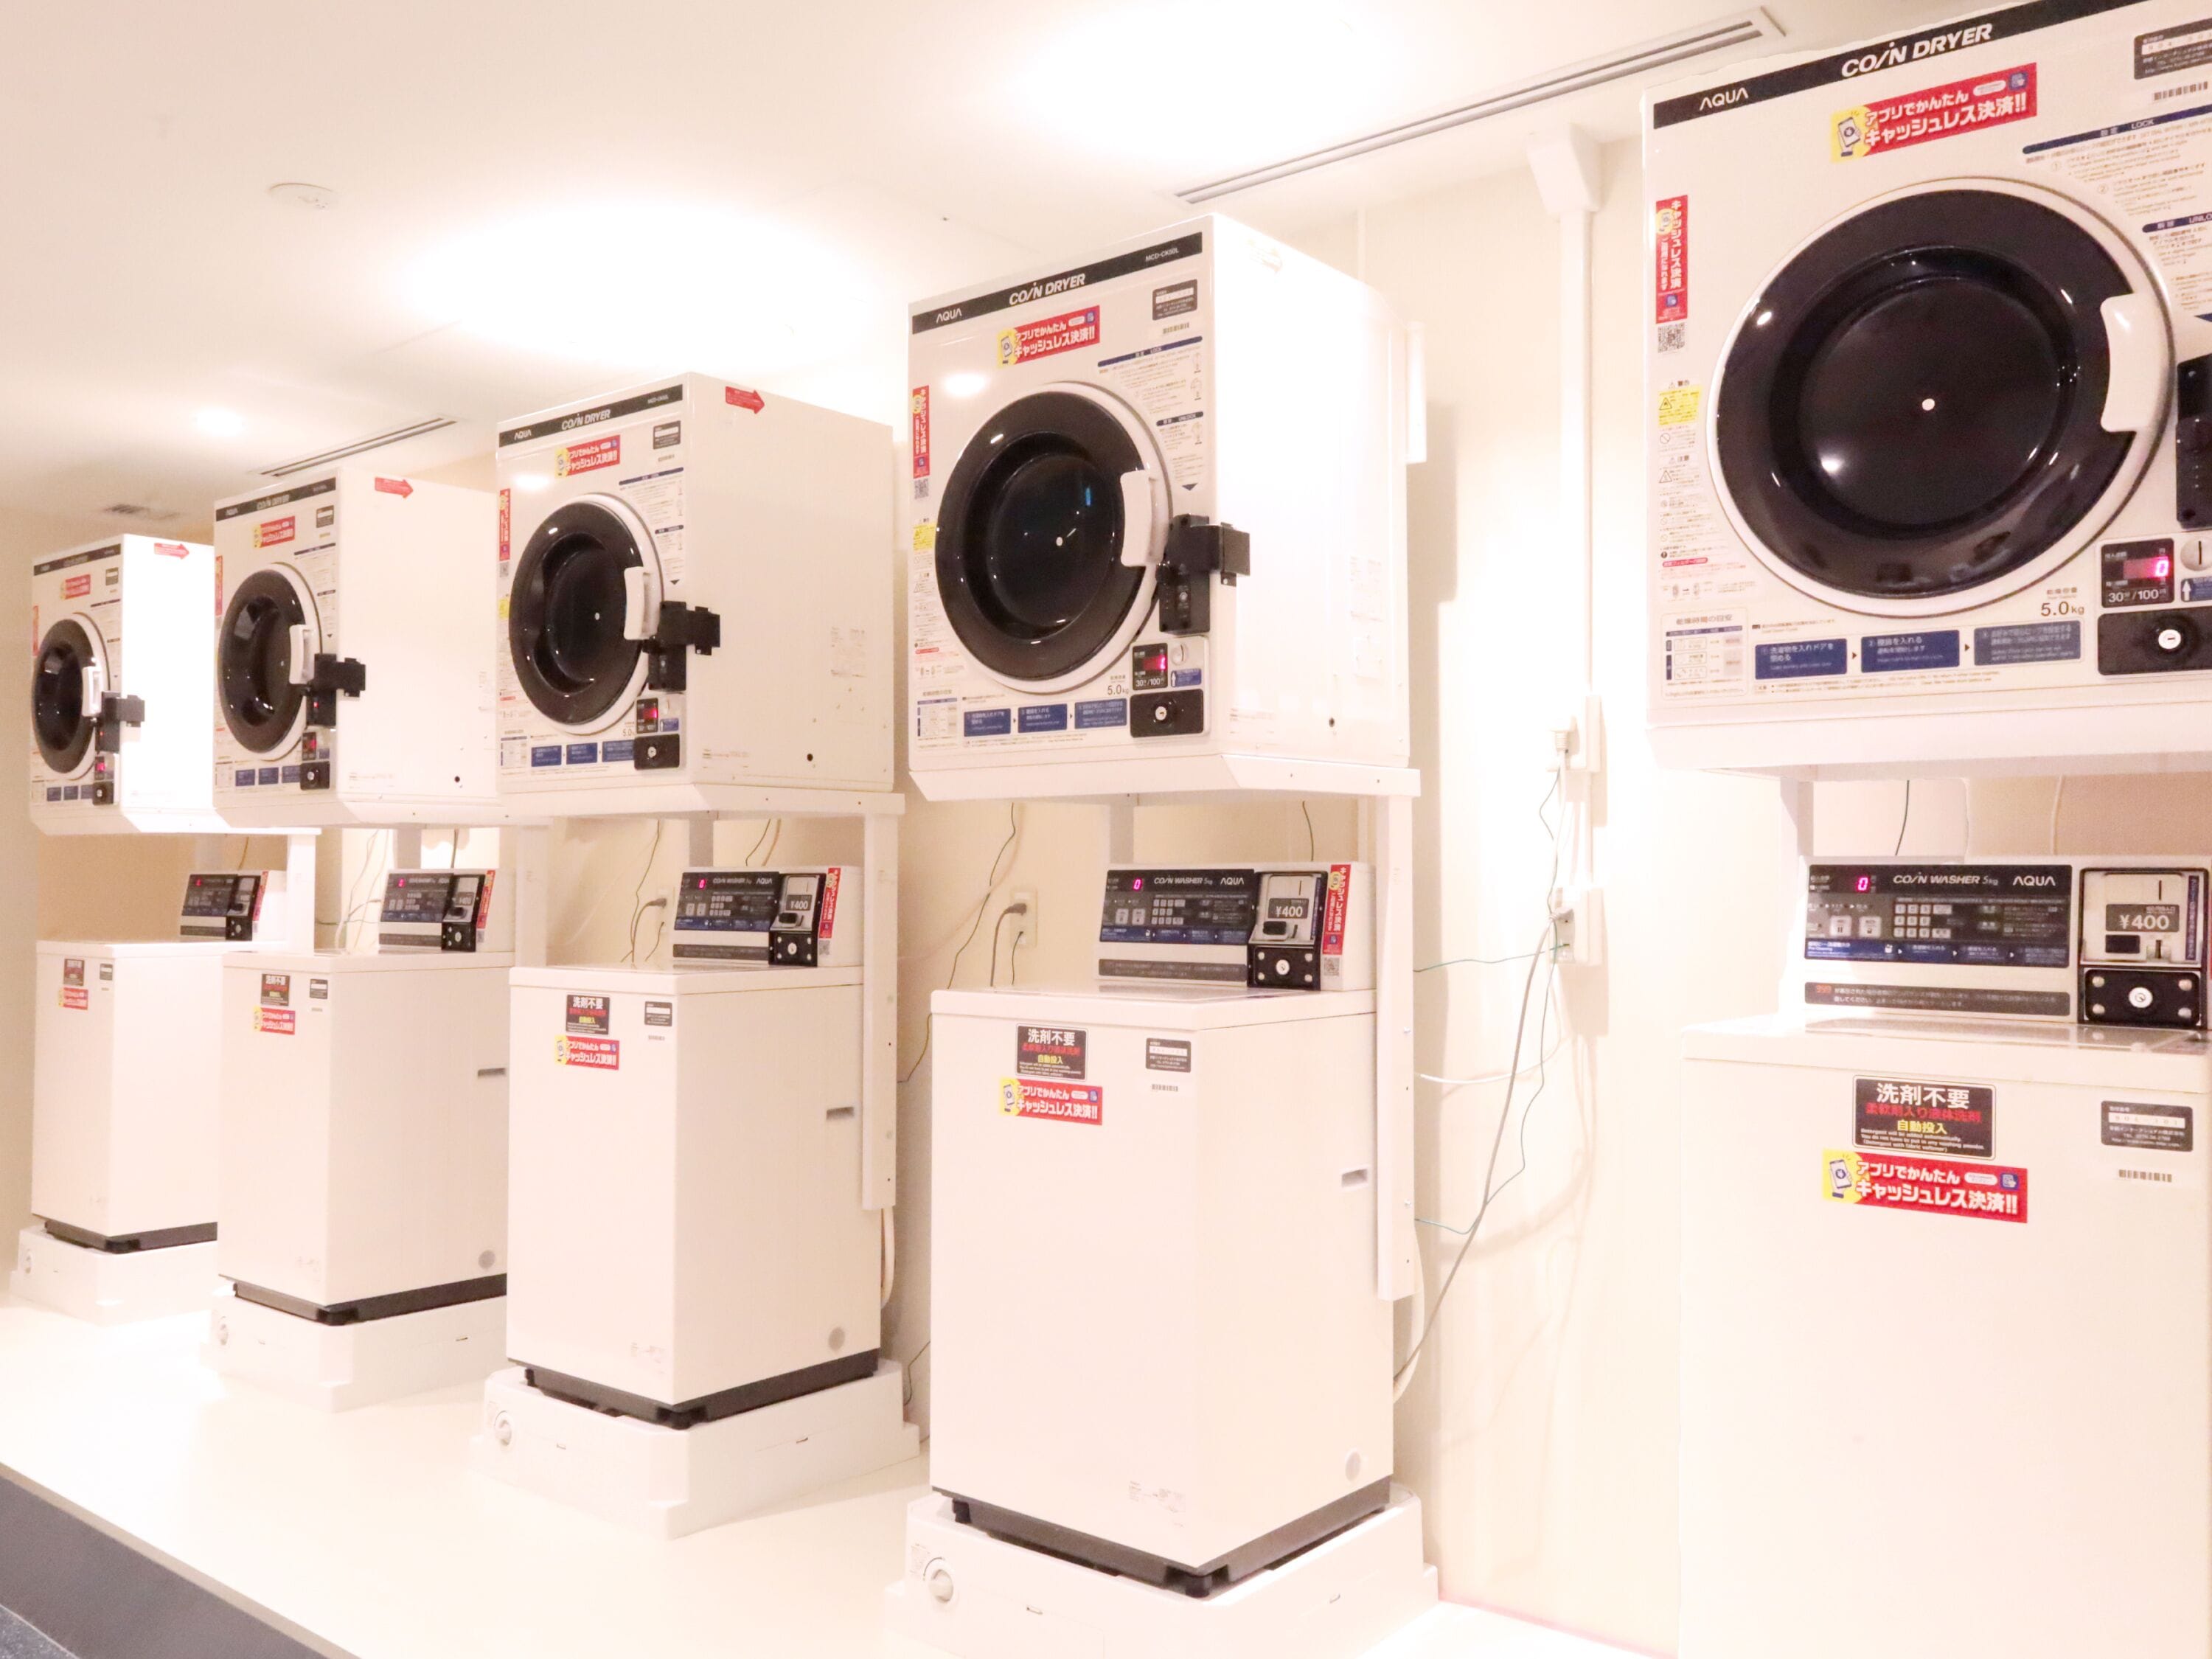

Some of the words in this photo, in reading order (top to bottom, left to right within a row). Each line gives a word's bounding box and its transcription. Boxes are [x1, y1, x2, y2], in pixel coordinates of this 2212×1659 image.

[1913, 24, 1993, 59] DRYER
[1699, 86, 1749, 111] AQUA
[1865, 89, 1969, 127] アプリでかんたん
[1045, 273, 1085, 296] DRYER
[936, 307, 962, 324] AQUA
[1015, 321, 1067, 344] アプリでかんたん
[585, 409, 611, 425] DRYER
[514, 430, 531, 440] AQUA
[2154, 559, 2169, 577] 0
[1133, 878, 1141, 891] 0
[1220, 877, 1244, 886] AQUA
[1857, 877, 1868, 891] 0
[1930, 875, 1980, 884] WASHER
[2013, 875, 2056, 886] AQUA
[1276, 906, 1303, 917] ¥400
[2120, 914, 2169, 930] ¥400
[1028, 1028, 1075, 1046] 洗剤不要
[1018, 1085, 1069, 1099] アプリでかんたん
[1877, 1082, 1969, 1109] 洗剤不要
[1897, 1119, 1947, 1135] 自動投入
[1857, 1161, 1961, 1185] アプリでかんたん
